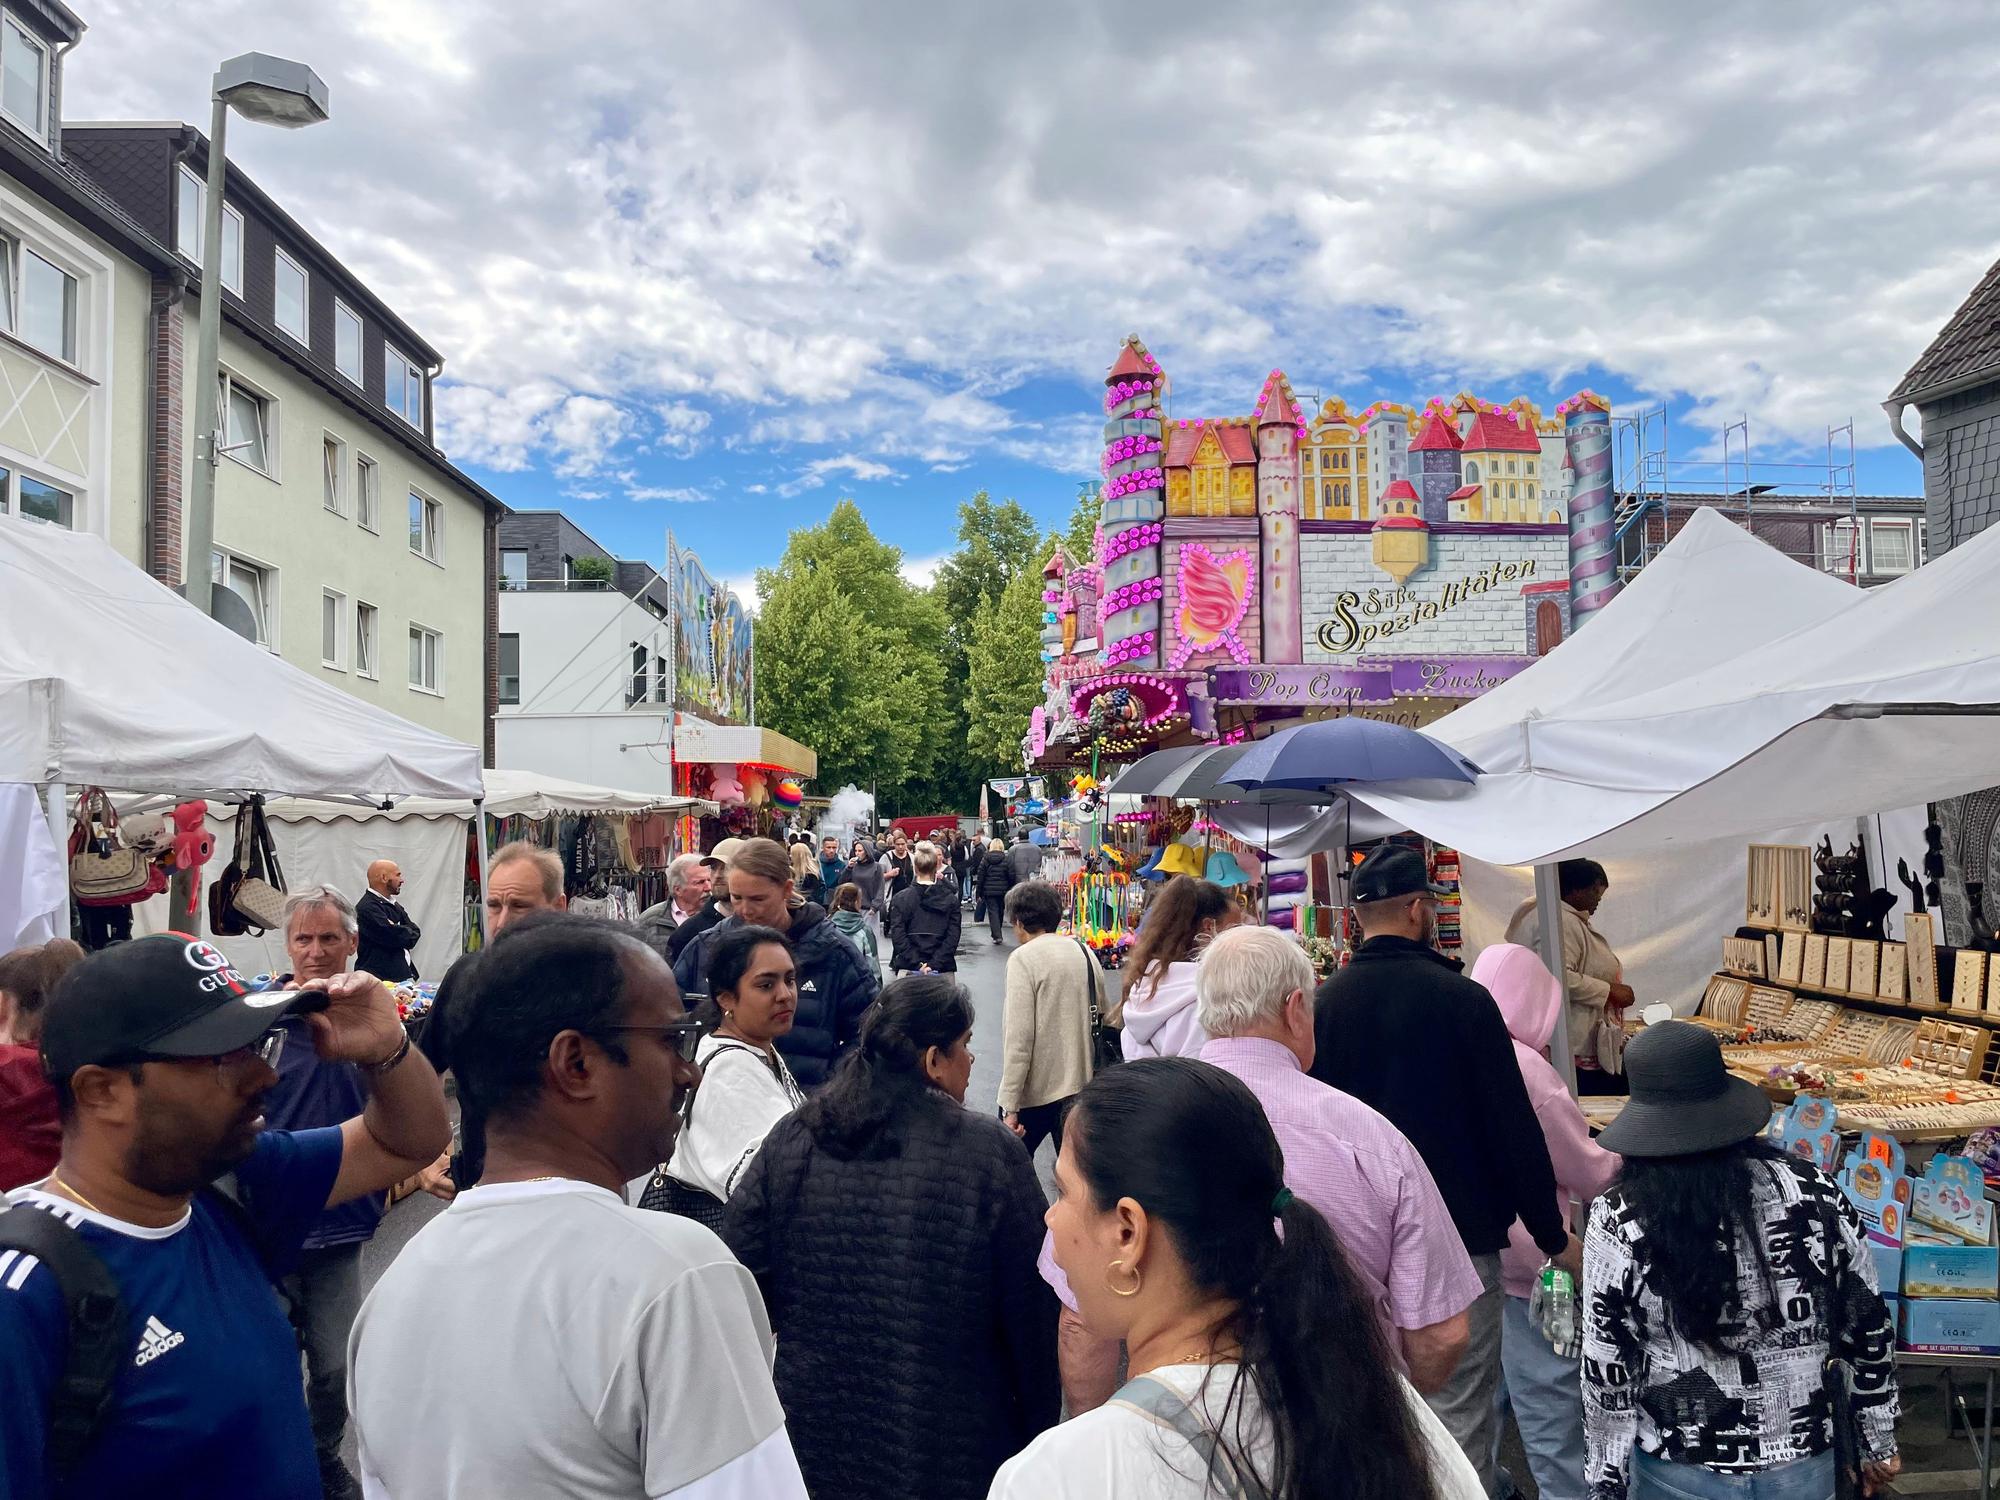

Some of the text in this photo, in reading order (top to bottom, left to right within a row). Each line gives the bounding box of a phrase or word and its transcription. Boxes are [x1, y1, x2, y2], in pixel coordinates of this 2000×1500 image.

[1316, 559, 1536, 653] Spezialitäten
[1362, 585, 1416, 617] Süße
[1249, 671, 1363, 699] Pop Corn
[1420, 663, 1509, 691] Zucker
[135, 1331, 185, 1367] adidas
